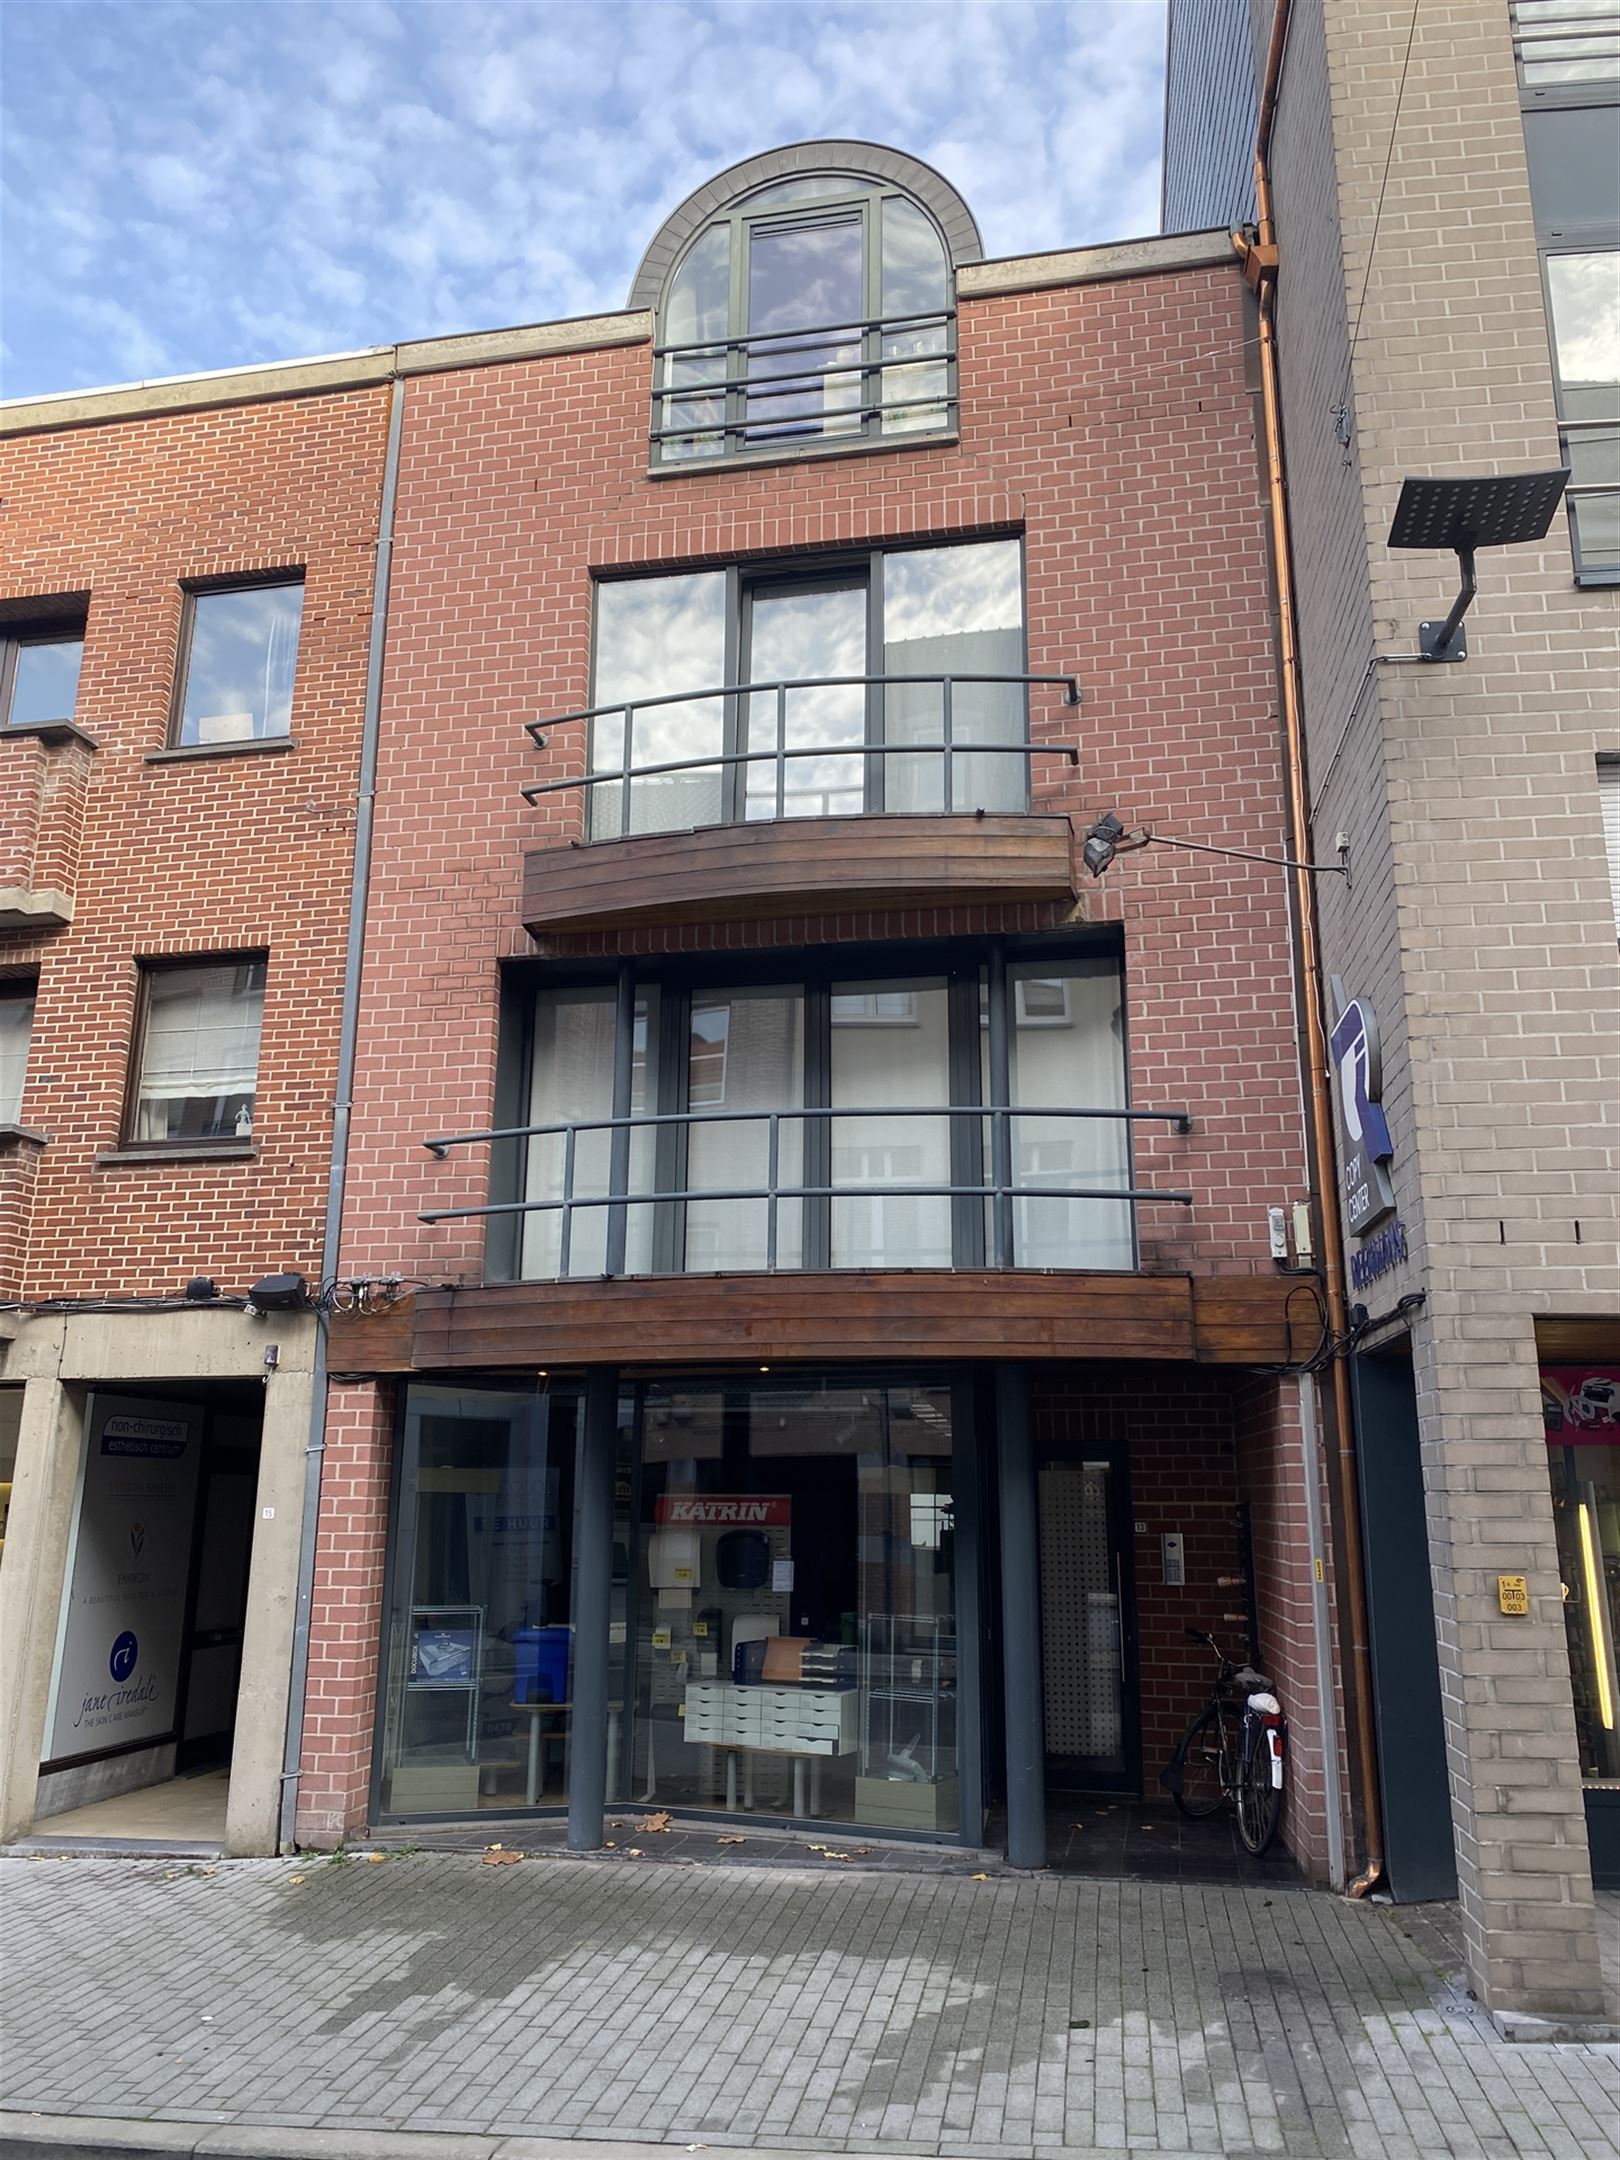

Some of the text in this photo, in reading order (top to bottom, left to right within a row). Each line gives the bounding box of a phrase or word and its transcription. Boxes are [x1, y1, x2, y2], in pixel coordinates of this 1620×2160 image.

[1346, 1153, 1361, 1190] COPY
[1348, 1183, 1370, 1223] CENTER
[111, 1420, 182, 1439] non-chirurgisch
[265, 1509, 272, 1517] 15
[670, 1502, 770, 1521] KATRIN
[506, 1517, 549, 1530] HUUR
[1507, 1603, 1522, 1611] 003
[73, 1692, 107, 1727] jane
